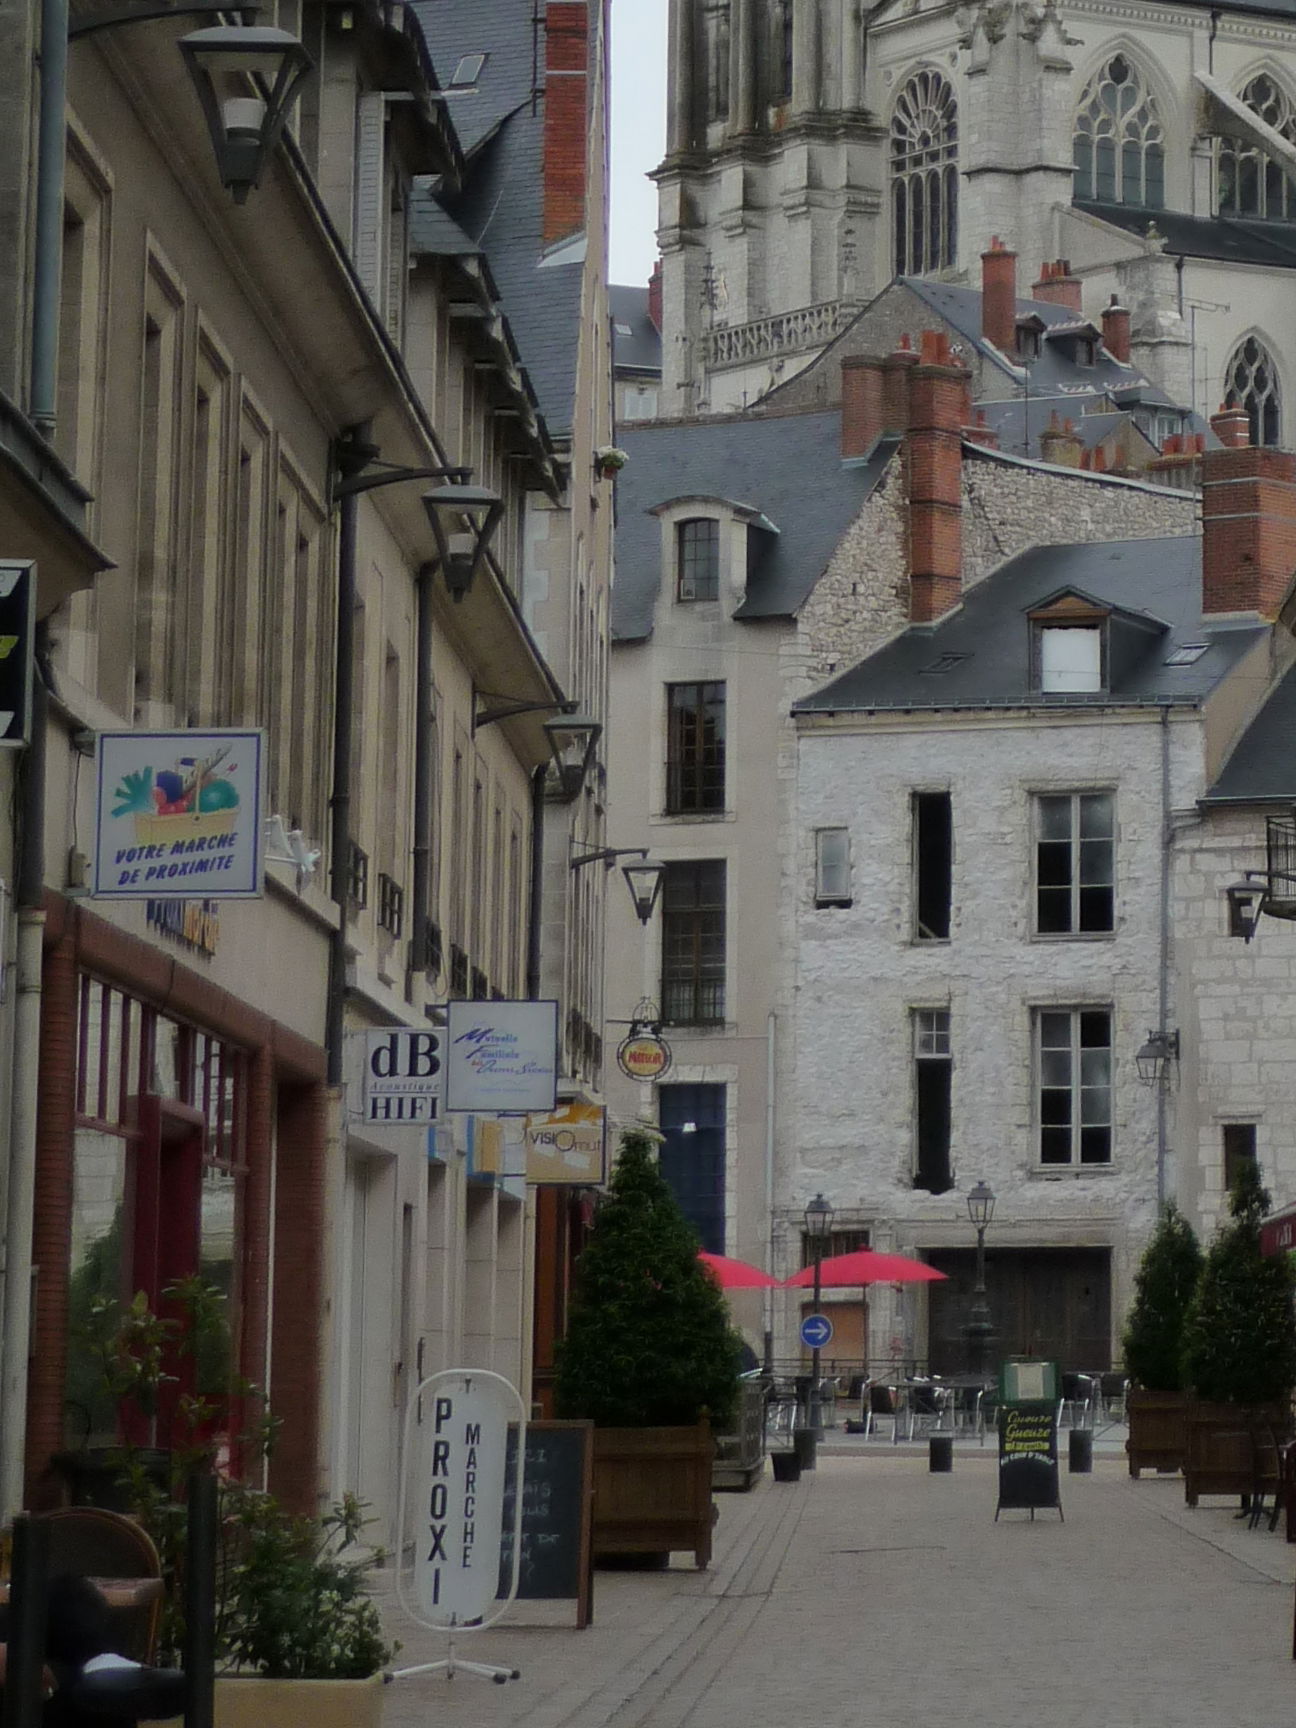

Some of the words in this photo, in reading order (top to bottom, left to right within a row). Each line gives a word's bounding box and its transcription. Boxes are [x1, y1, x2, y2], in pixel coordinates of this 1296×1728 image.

[114, 843, 167, 865] VOTRE
[170, 832, 239, 856] MARCHE
[118, 869, 142, 886] DE
[145, 854, 236, 881] PROXIMITE
[453, 1028, 519, 1044] Mutuelle
[370, 1032, 441, 1078] dB
[370, 1081, 440, 1093] Acoustique
[370, 1096, 440, 1121] HIFI
[427, 1397, 452, 1605] PROXI
[462, 1423, 481, 1568] MARCHE
